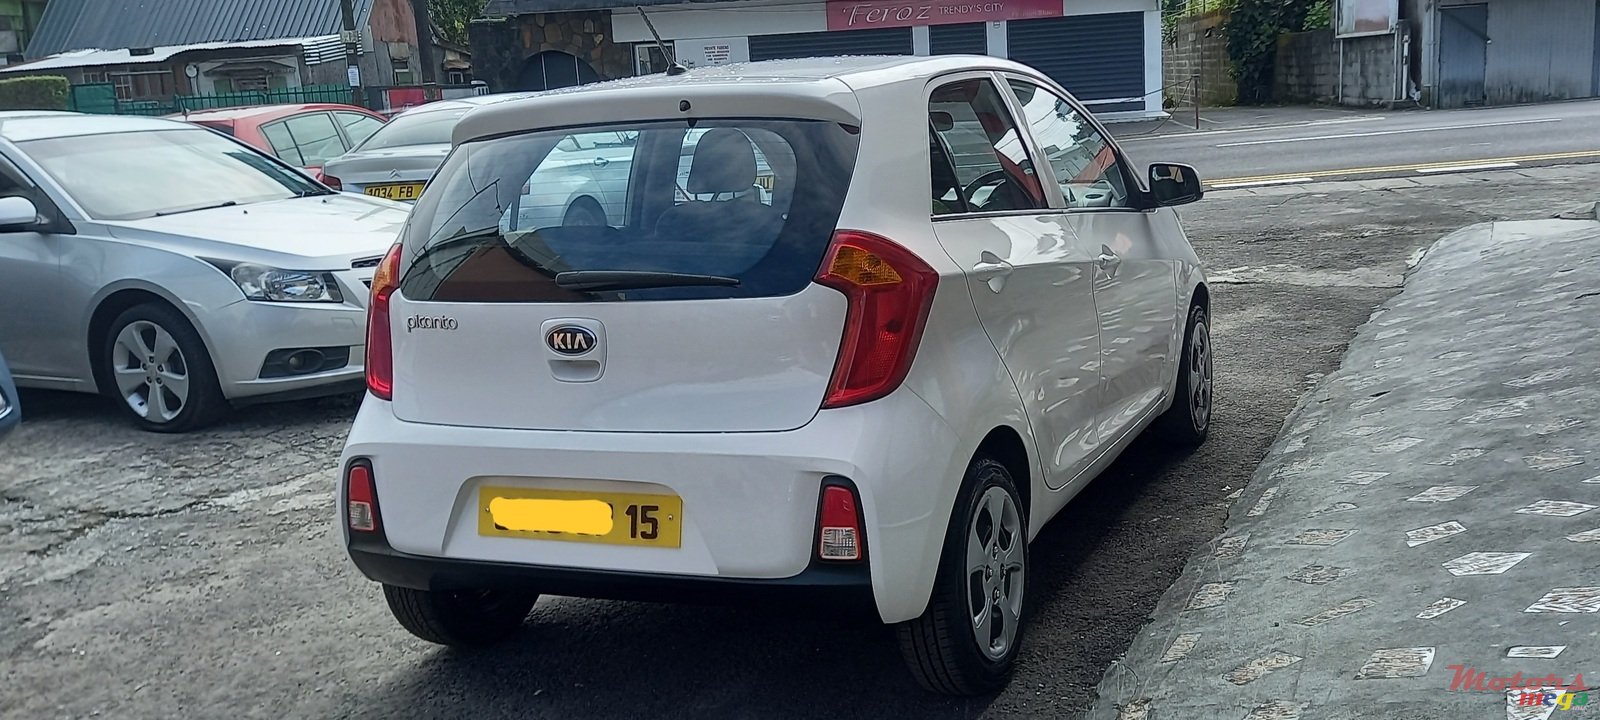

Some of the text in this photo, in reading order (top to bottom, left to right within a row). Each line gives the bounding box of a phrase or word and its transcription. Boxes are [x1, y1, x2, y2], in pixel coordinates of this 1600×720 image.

[938, 4, 982, 15] TRENDY'S
[984, 2, 1005, 12] CITY
[399, 186, 413, 198] FB
[407, 314, 458, 332] picanto
[553, 332, 588, 350] KIA
[624, 504, 660, 540] 15
